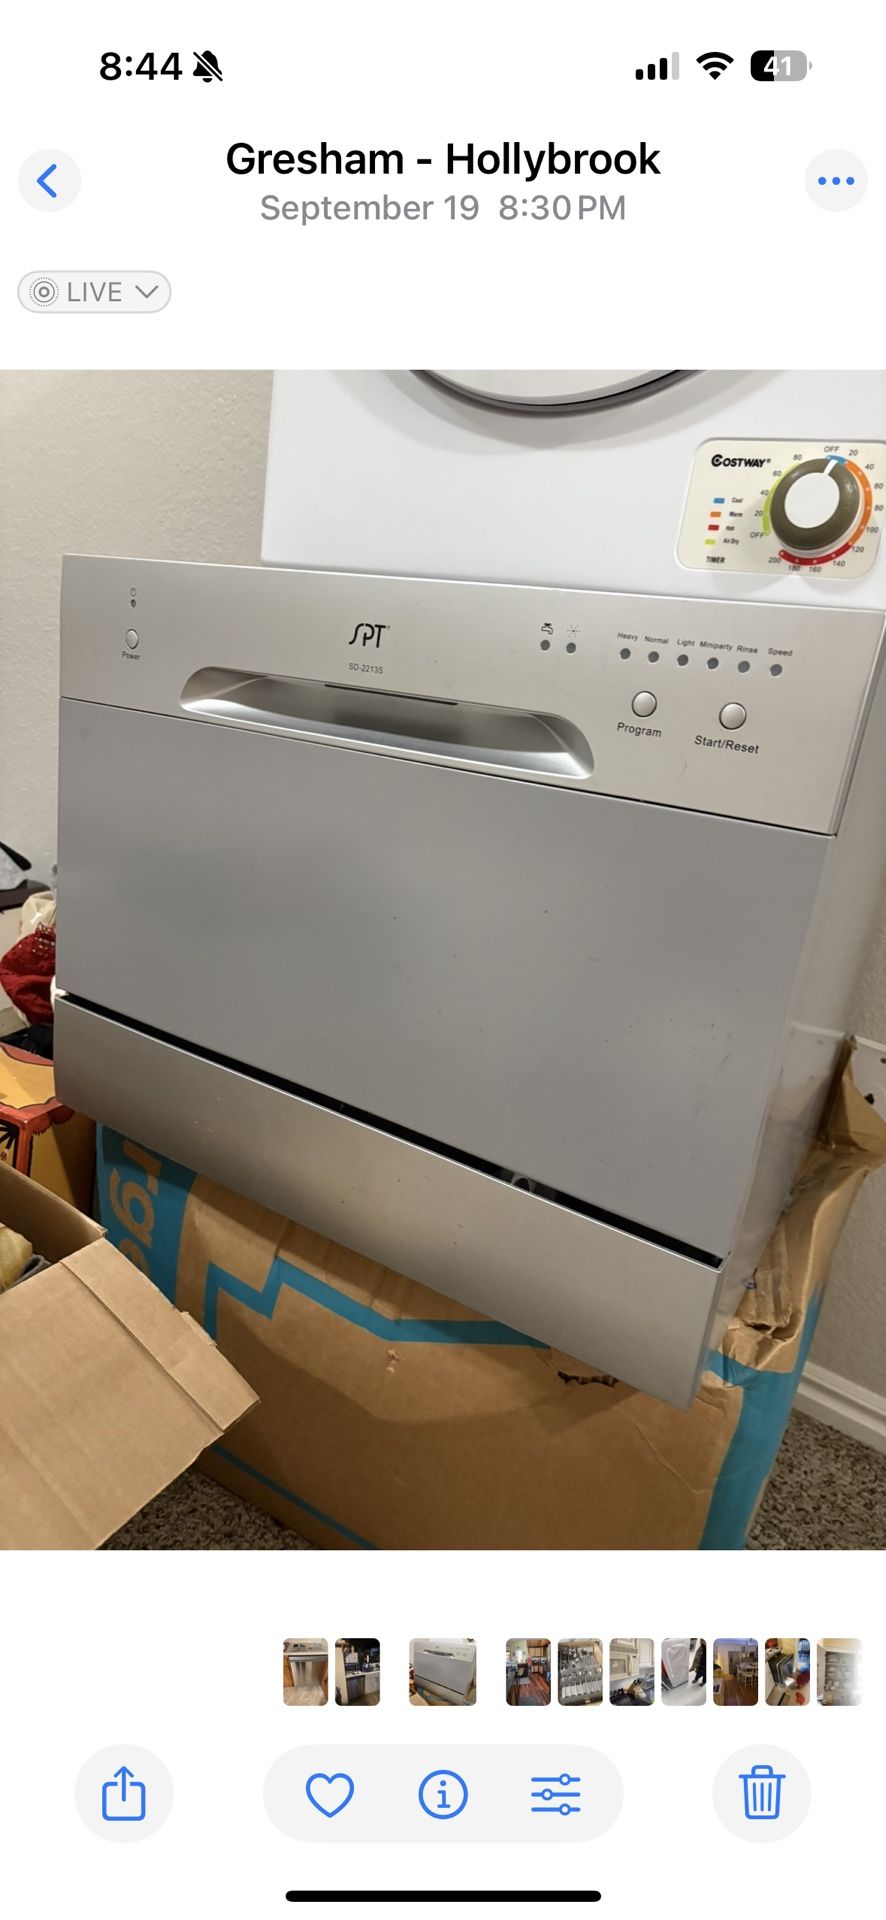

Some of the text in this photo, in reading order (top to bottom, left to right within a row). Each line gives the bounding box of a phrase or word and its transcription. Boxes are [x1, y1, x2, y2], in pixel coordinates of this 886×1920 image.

[99, 52, 183, 82] 8:44
[763, 54, 793, 78] 41
[226, 142, 404, 175] Gresham
[446, 140, 660, 182] Hollybrook
[260, 194, 626, 226] September 19 8:30 PM
[67, 282, 123, 302] LIVE
[348, 622, 386, 648] SPT
[617, 632, 793, 657] Heavy Normal Light Miniparty Rinse Speed
[122, 651, 140, 660] Power
[348, 662, 384, 674] SD-2213S
[617, 722, 662, 738] Program
[694, 735, 760, 754] Start/Reset
